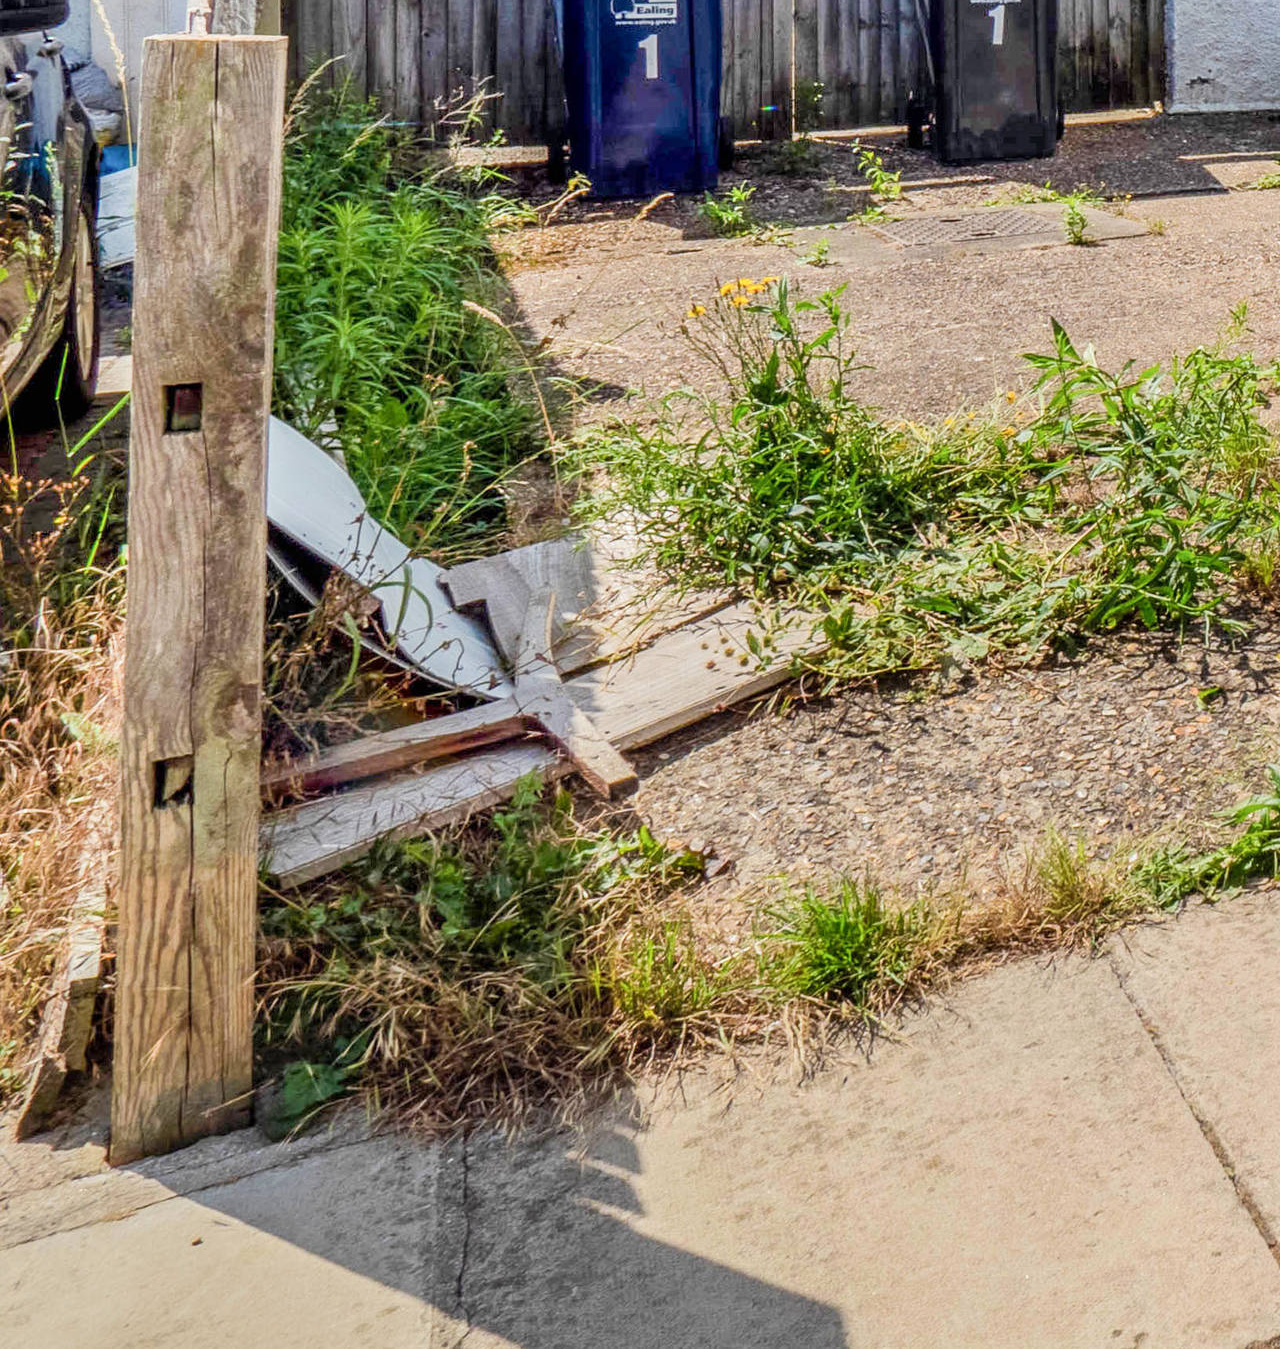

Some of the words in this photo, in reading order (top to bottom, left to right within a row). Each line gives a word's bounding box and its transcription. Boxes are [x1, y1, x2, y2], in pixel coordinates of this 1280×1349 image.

[636, 5, 674, 16] Ealing
[988, 4, 1005, 45] 1
[638, 34, 658, 79] 1
